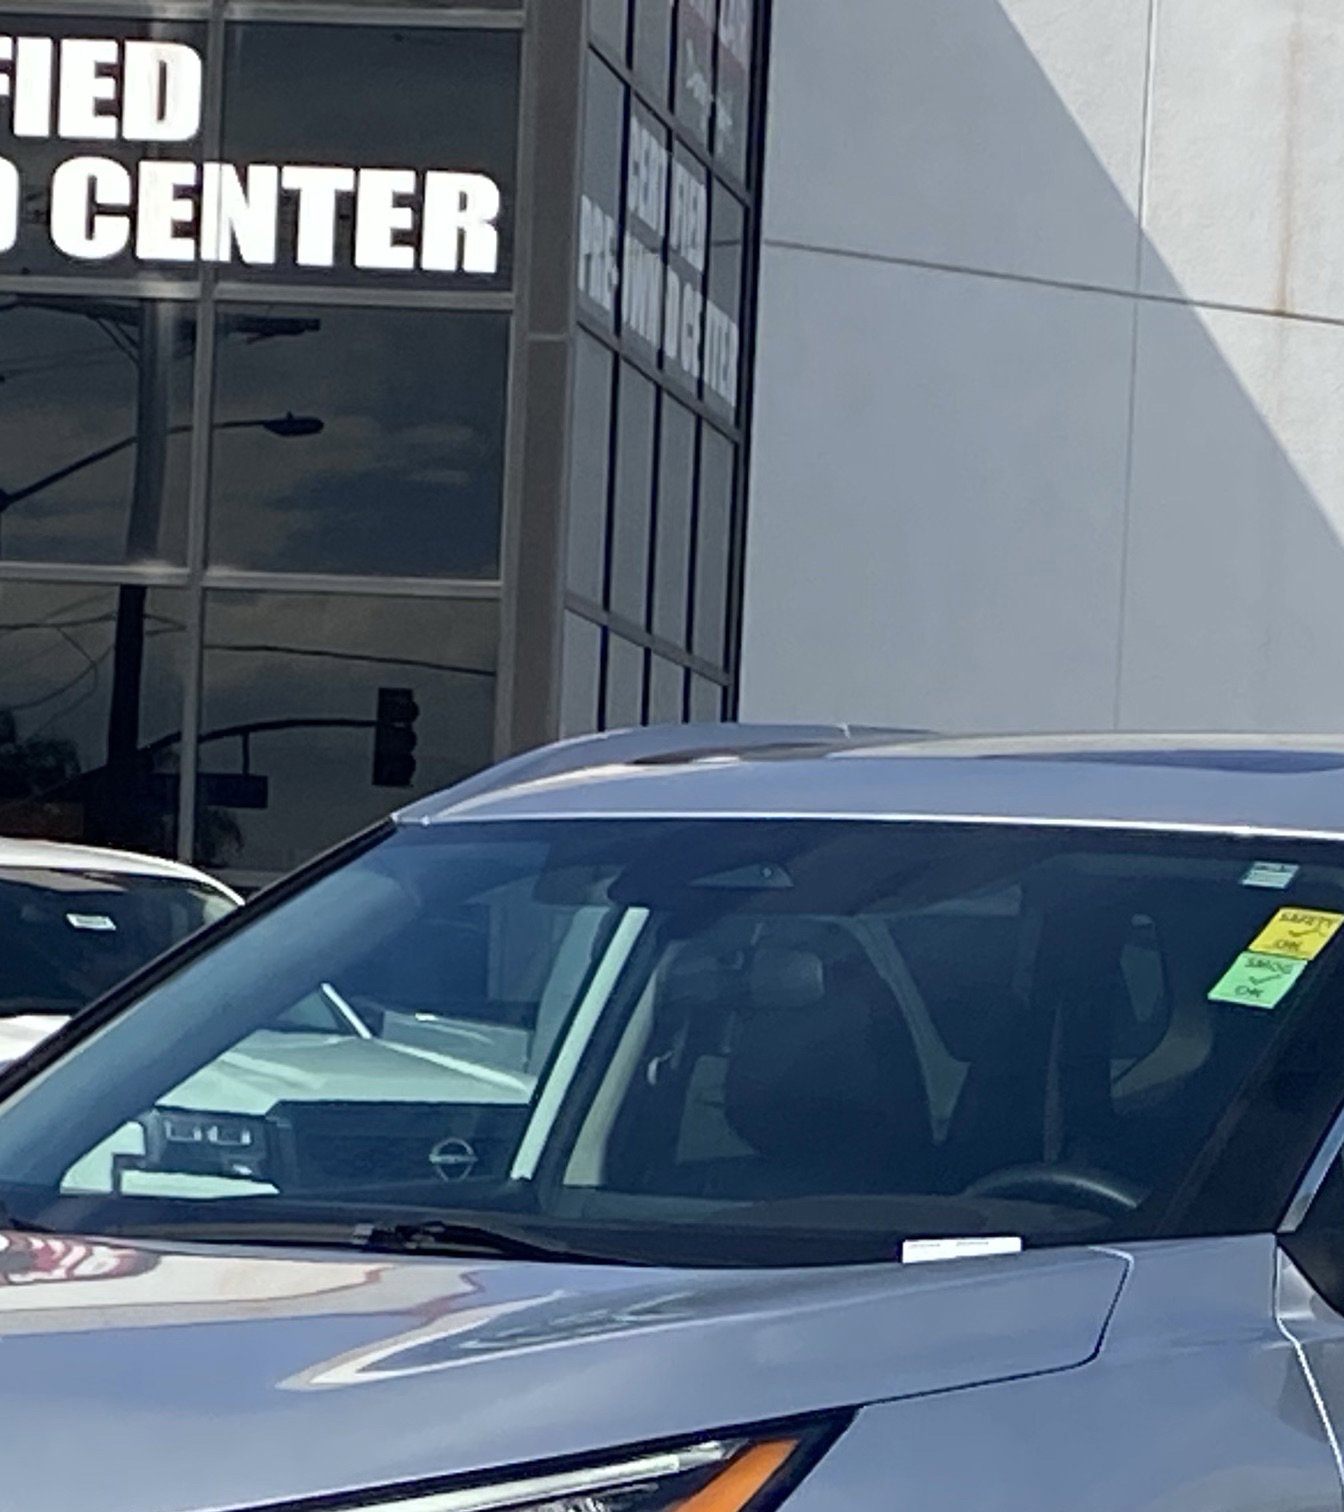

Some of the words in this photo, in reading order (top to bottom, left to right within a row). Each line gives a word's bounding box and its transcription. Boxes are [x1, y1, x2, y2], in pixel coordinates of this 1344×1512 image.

[50, 155, 503, 274] CENTER
[1273, 940, 1302, 952] OK
[1234, 985, 1265, 999] OK
